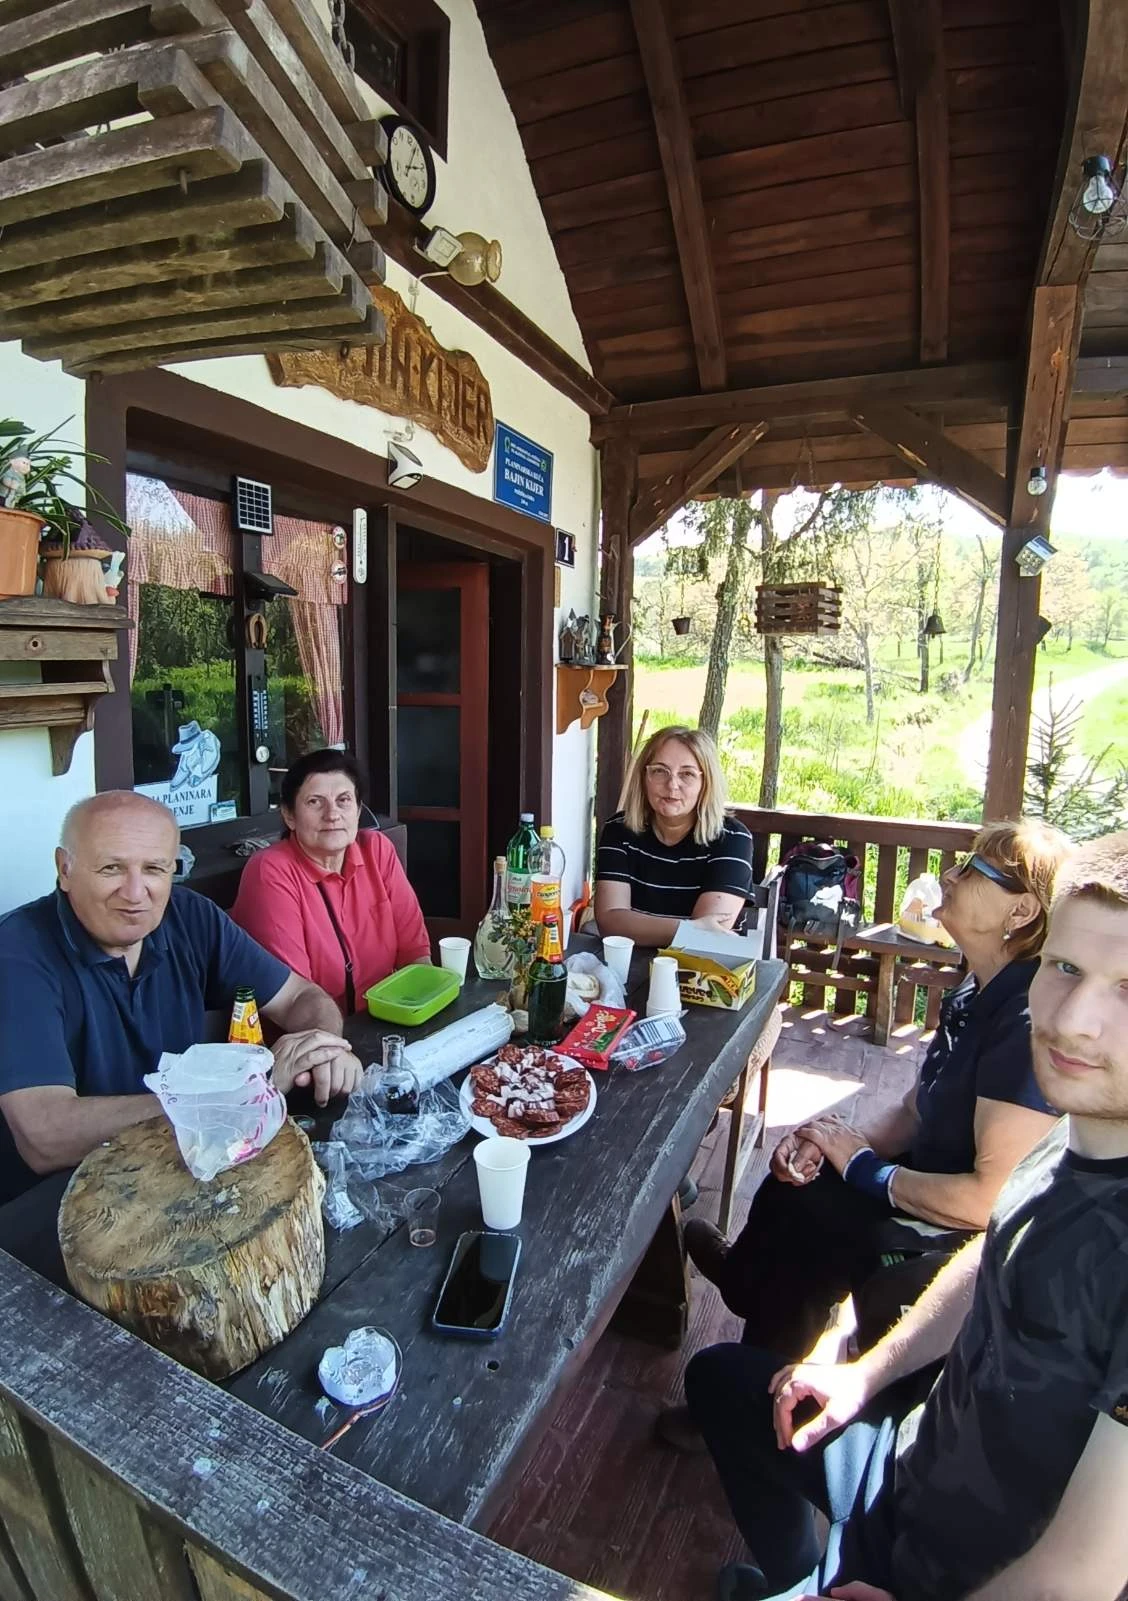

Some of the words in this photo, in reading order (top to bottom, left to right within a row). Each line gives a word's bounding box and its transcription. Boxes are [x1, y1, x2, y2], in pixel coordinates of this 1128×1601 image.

[504, 467, 525, 488] BAJIN
[563, 536, 569, 561] 1
[163, 788, 212, 804] PLANINARA
[173, 804, 195, 817] ENJE
